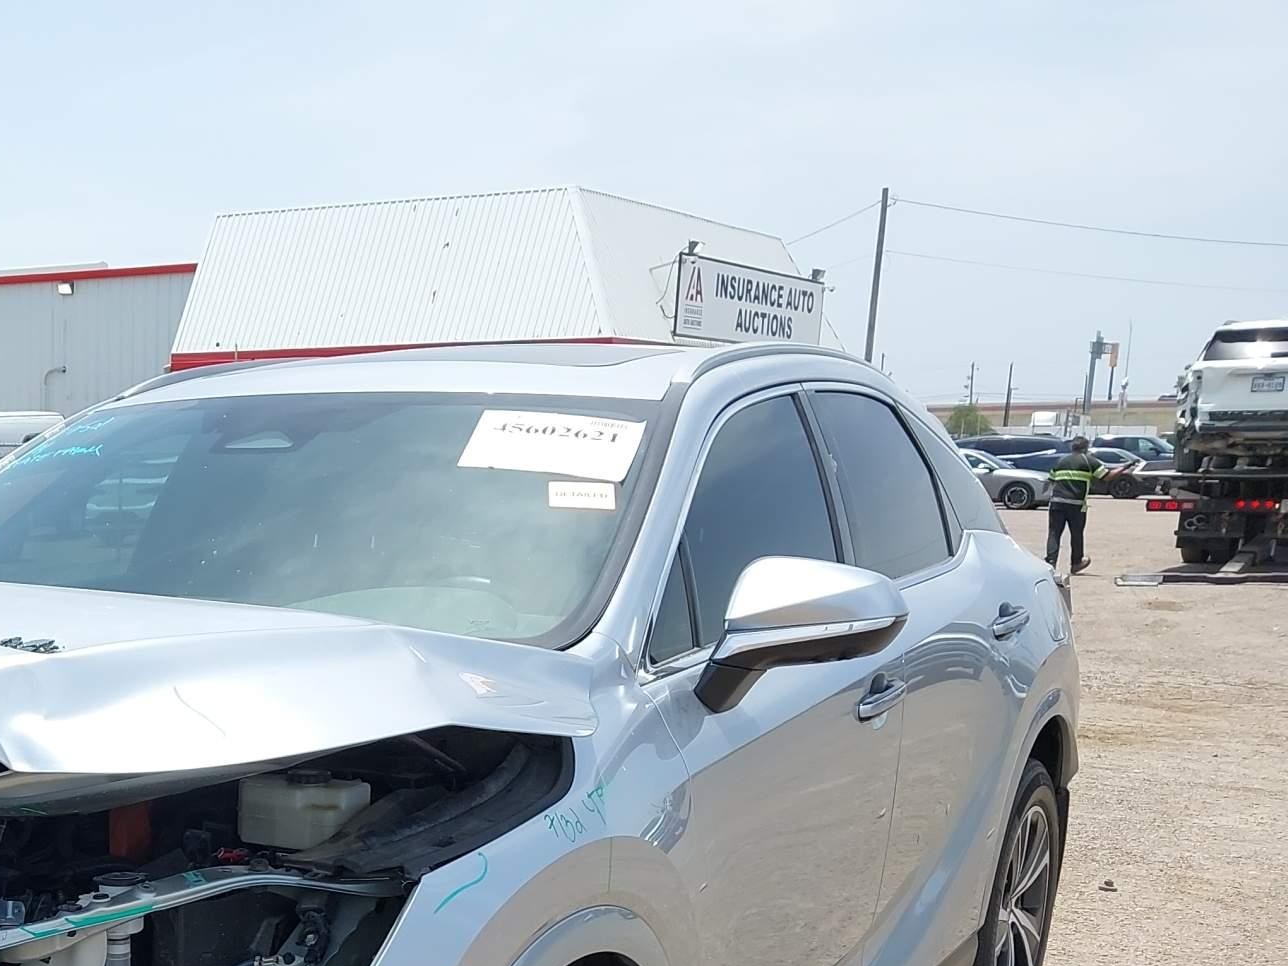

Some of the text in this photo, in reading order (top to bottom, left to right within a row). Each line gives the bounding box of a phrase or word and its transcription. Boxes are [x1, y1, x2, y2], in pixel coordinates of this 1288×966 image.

[715, 272, 815, 314] INSURANCE AUTO
[735, 308, 793, 340] AUCTIONS
[494, 422, 618, 443] 45602621
